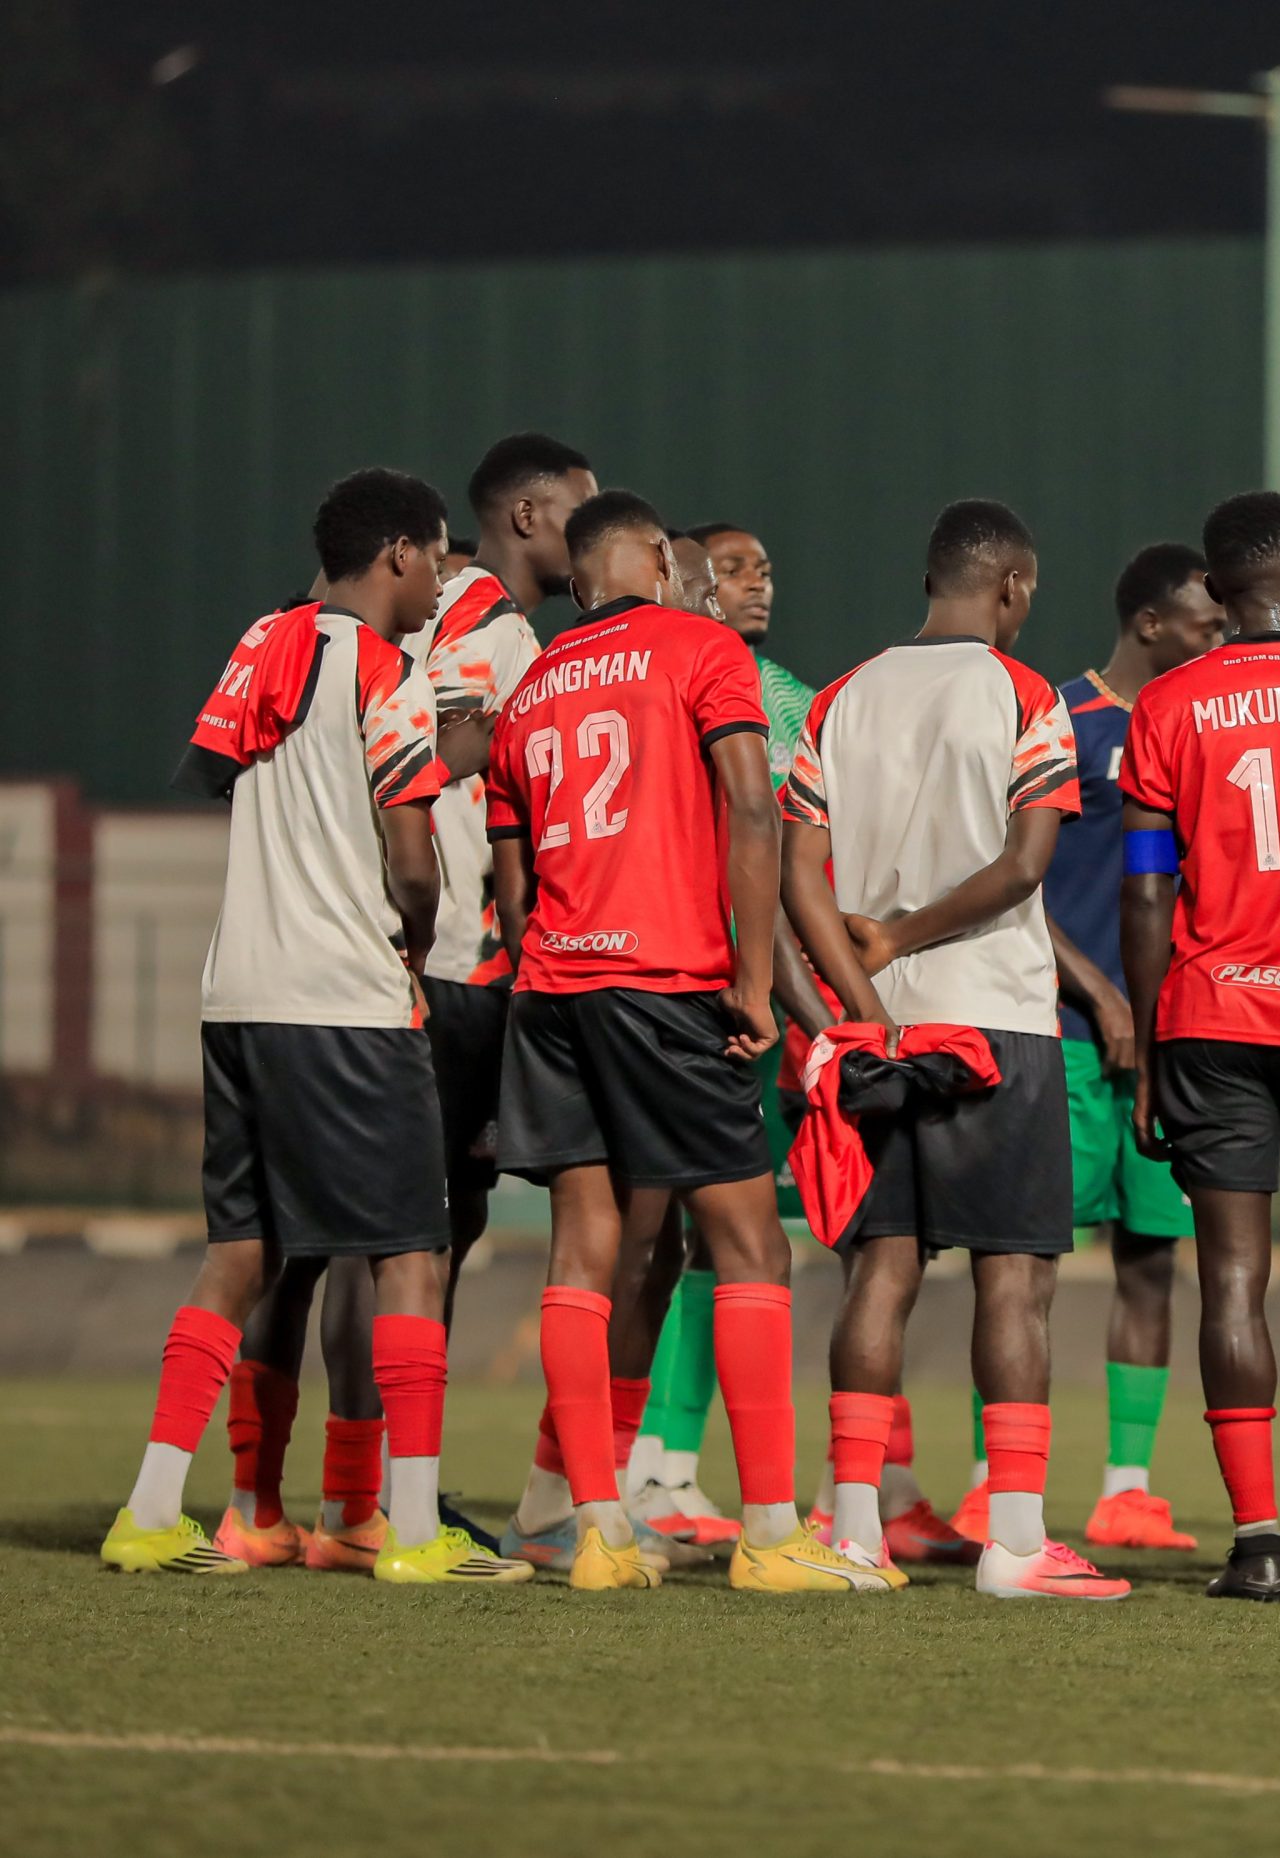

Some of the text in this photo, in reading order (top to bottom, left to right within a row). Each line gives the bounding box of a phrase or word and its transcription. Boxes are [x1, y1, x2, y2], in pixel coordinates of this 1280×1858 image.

[509, 650, 651, 724] YOUNGMAN
[1242, 654, 1267, 662] TEAM
[525, 710, 631, 852] 22
